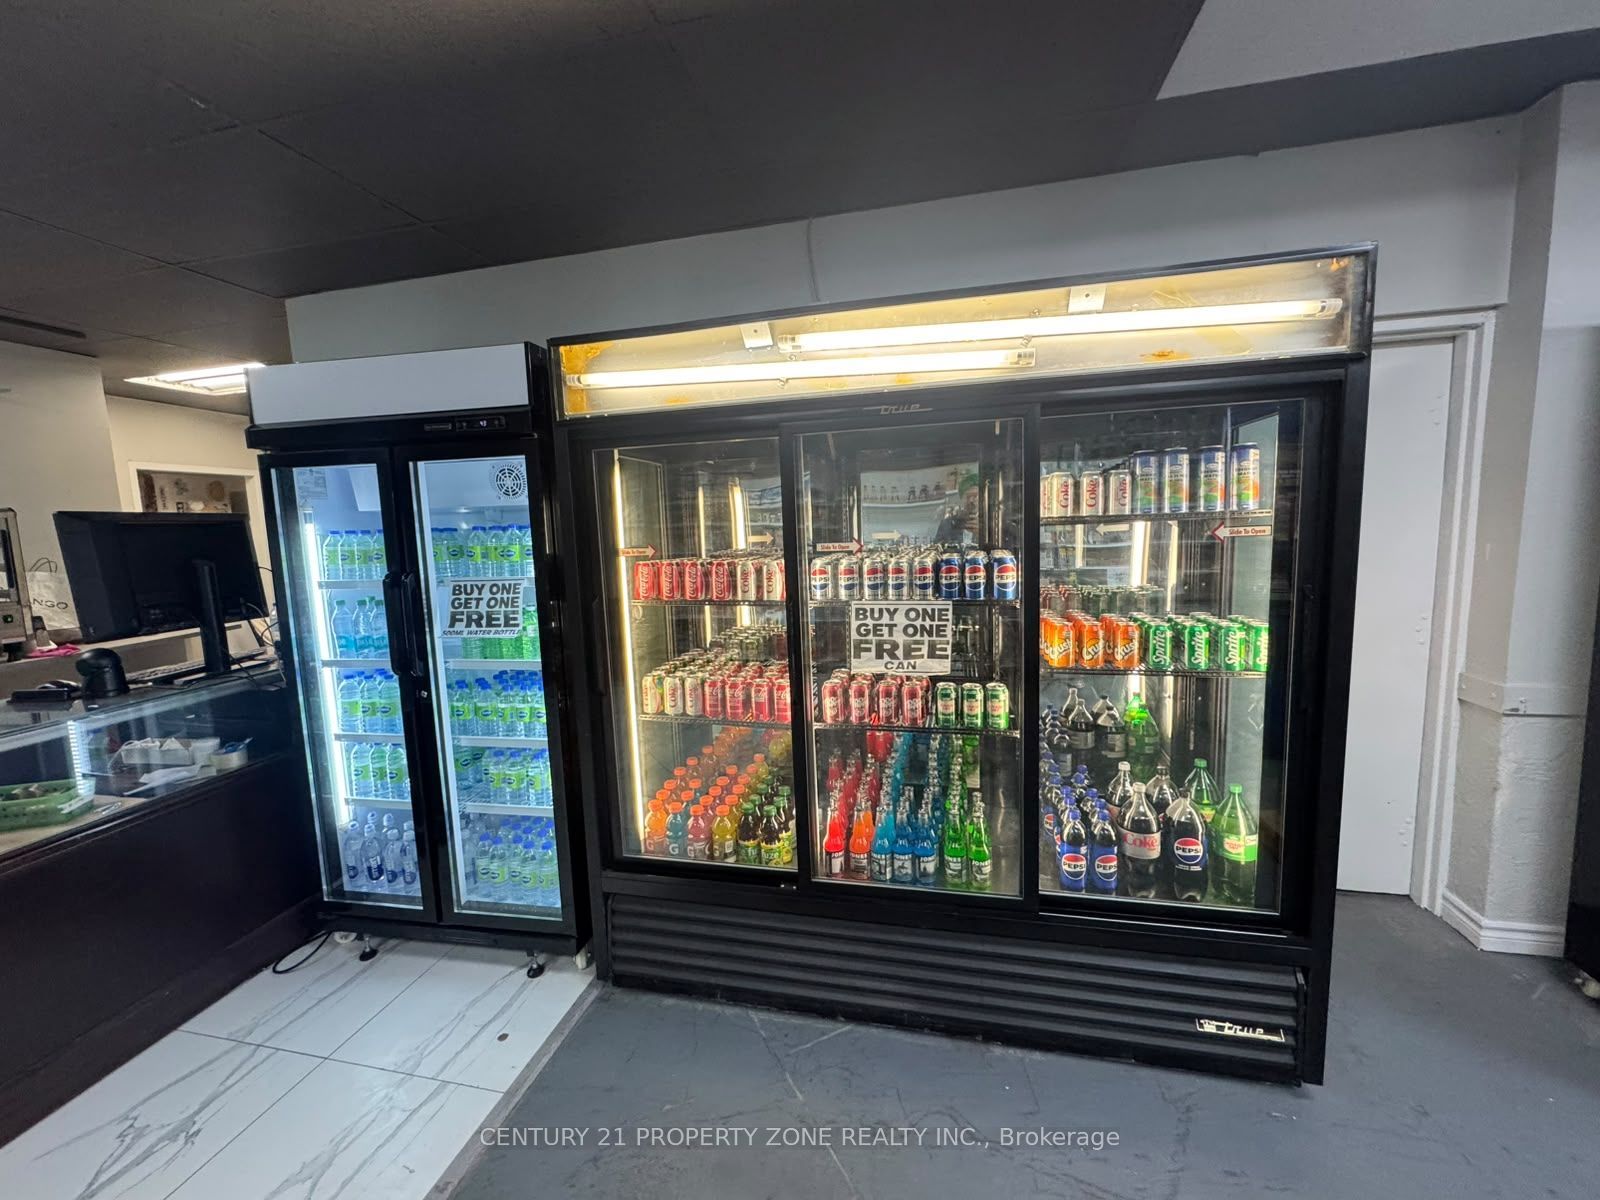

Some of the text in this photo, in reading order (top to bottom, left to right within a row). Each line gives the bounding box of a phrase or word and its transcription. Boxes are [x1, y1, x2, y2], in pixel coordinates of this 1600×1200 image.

[1085, 479, 1098, 508] Coke
[451, 582, 522, 596] BUY ONE
[32, 598, 69, 610] NGO
[450, 596, 520, 610] GET ONE
[448, 610, 520, 628] FREE
[854, 607, 950, 622] BUY ONE
[855, 622, 948, 638] GET ONE
[853, 639, 950, 660] FREE
[1152, 630, 1166, 665] Sprite
[1191, 631, 1205, 665] Sprite
[1225, 631, 1240, 666] Sprite
[884, 661, 917, 670] CAN
[1121, 832, 1158, 849] Coke
[669, 843, 679, 855] G
[1175, 845, 1201, 854] PEPSI
[1063, 861, 1086, 870] PEPSI
[1096, 863, 1117, 871] PEPS
